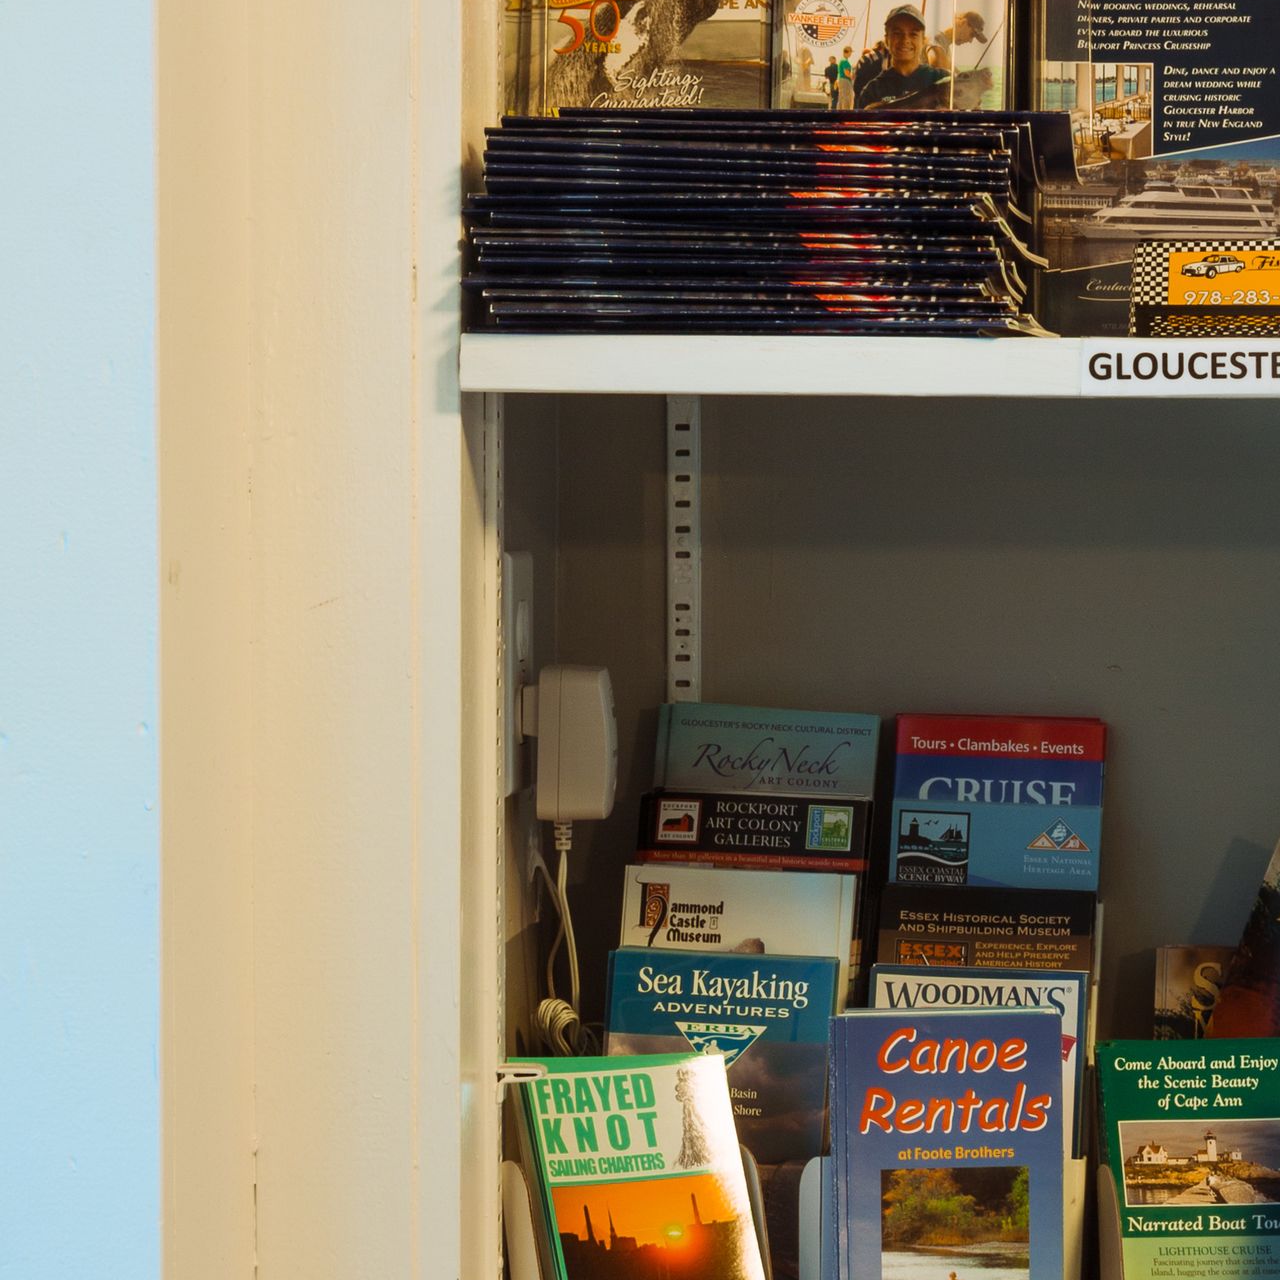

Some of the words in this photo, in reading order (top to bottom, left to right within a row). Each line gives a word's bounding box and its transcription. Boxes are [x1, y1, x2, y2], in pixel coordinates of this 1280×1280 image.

[912, 736, 946, 750] Tours
[958, 738, 1029, 754] Clambakes
[1040, 742, 1084, 754] Events
[670, 916, 707, 930] Castle
[666, 929, 721, 944] Museum
[637, 966, 682, 996] Sea
[690, 968, 808, 1008] Kayaking
[652, 1002, 790, 1018] ADVENTURES
[878, 1027, 1026, 1073] Canoe
[1114, 1058, 1152, 1070] Come
[1157, 1056, 1206, 1071] Aboard
[1210, 1056, 1236, 1070] and
[1240, 1055, 1278, 1072] Enjoy
[1138, 1076, 1160, 1089] the
[1164, 1075, 1206, 1089] Scenic
[1212, 1074, 1258, 1092] Beauty
[537, 1074, 656, 1114] FRAYED
[1158, 1094, 1172, 1108] of
[1175, 1094, 1209, 1111] Cape
[1213, 1094, 1242, 1107] Ann
[860, 1082, 1051, 1135] Rentals
[541, 1114, 660, 1154] KNOT
[898, 1148, 910, 1160] at
[914, 1147, 951, 1160] Foote
[955, 1145, 1014, 1159] Brothers
[550, 1156, 595, 1176] SAILING
[599, 1152, 665, 1174] CHARTERS
[1128, 1216, 1202, 1233] Narrated
[1208, 1216, 1246, 1231] Boat
